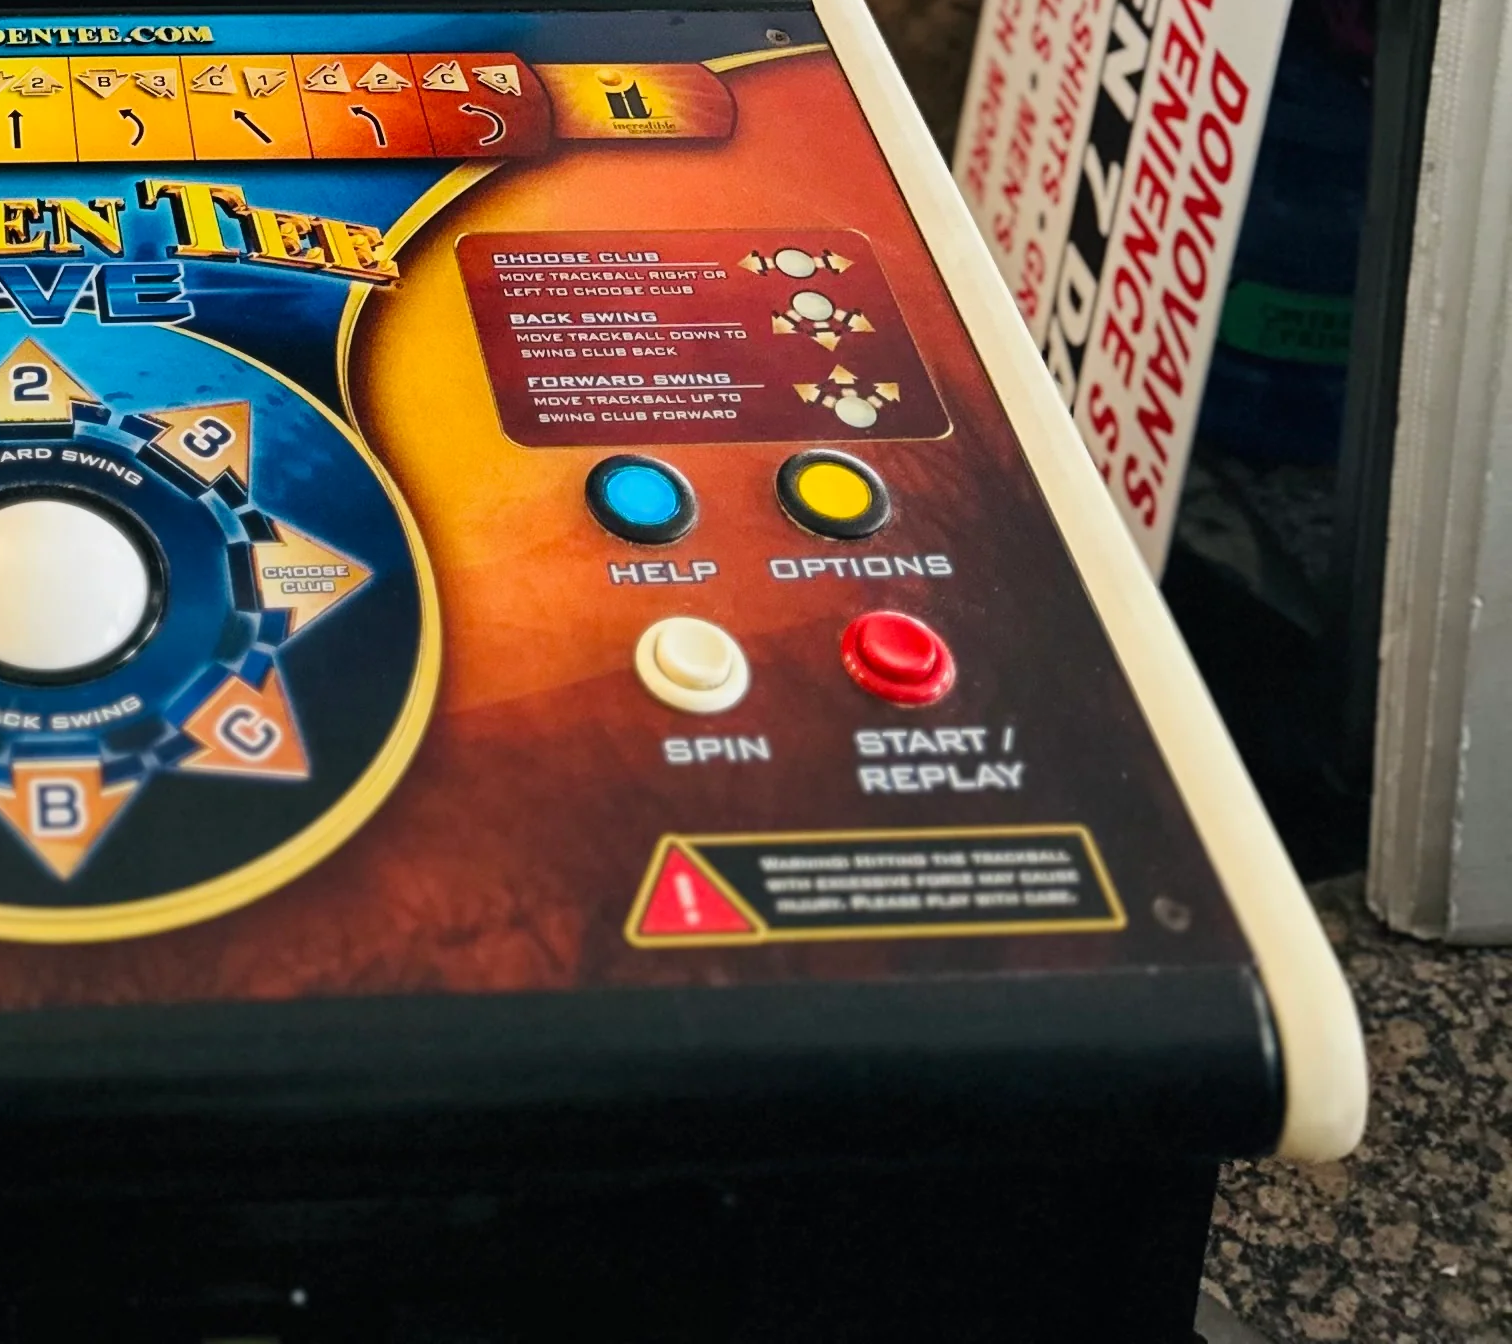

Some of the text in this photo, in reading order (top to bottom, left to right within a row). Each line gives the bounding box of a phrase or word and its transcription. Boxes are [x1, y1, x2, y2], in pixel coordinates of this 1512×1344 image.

[1084, 143, 1125, 238] 7
[136, 177, 402, 287] TEE
[492, 250, 660, 264] CHOOSE CLUB
[499, 269, 727, 282] MOVE TRACKBALL RIGHT OR
[1122, 48, 1250, 528] DONOVAN'S
[504, 284, 694, 298] LEFT TO CHOOSE CLUB
[509, 310, 658, 325] BACK SWING
[516, 328, 747, 342] MOVE TRACKBALL DOWN TO
[520, 345, 678, 359] SWING CLUB BACK
[10, 364, 50, 403] 2
[527, 373, 731, 388] FORWARD SWING
[533, 392, 742, 407] MOVE TRACKBALL UP TO
[538, 409, 738, 423] SWING CLUB FORWARD
[182, 417, 234, 458] 3
[60, 448, 145, 488] SWING
[262, 564, 350, 580] CHOOSE
[609, 554, 953, 585] HELP OPTIONS
[281, 579, 336, 595] CLUB
[51, 694, 143, 730] SWING
[214, 704, 280, 759] C
[854, 727, 987, 756] START
[662, 736, 771, 766] SPIN
[857, 763, 1024, 794] REPLAY
[31, 782, 84, 836] B
